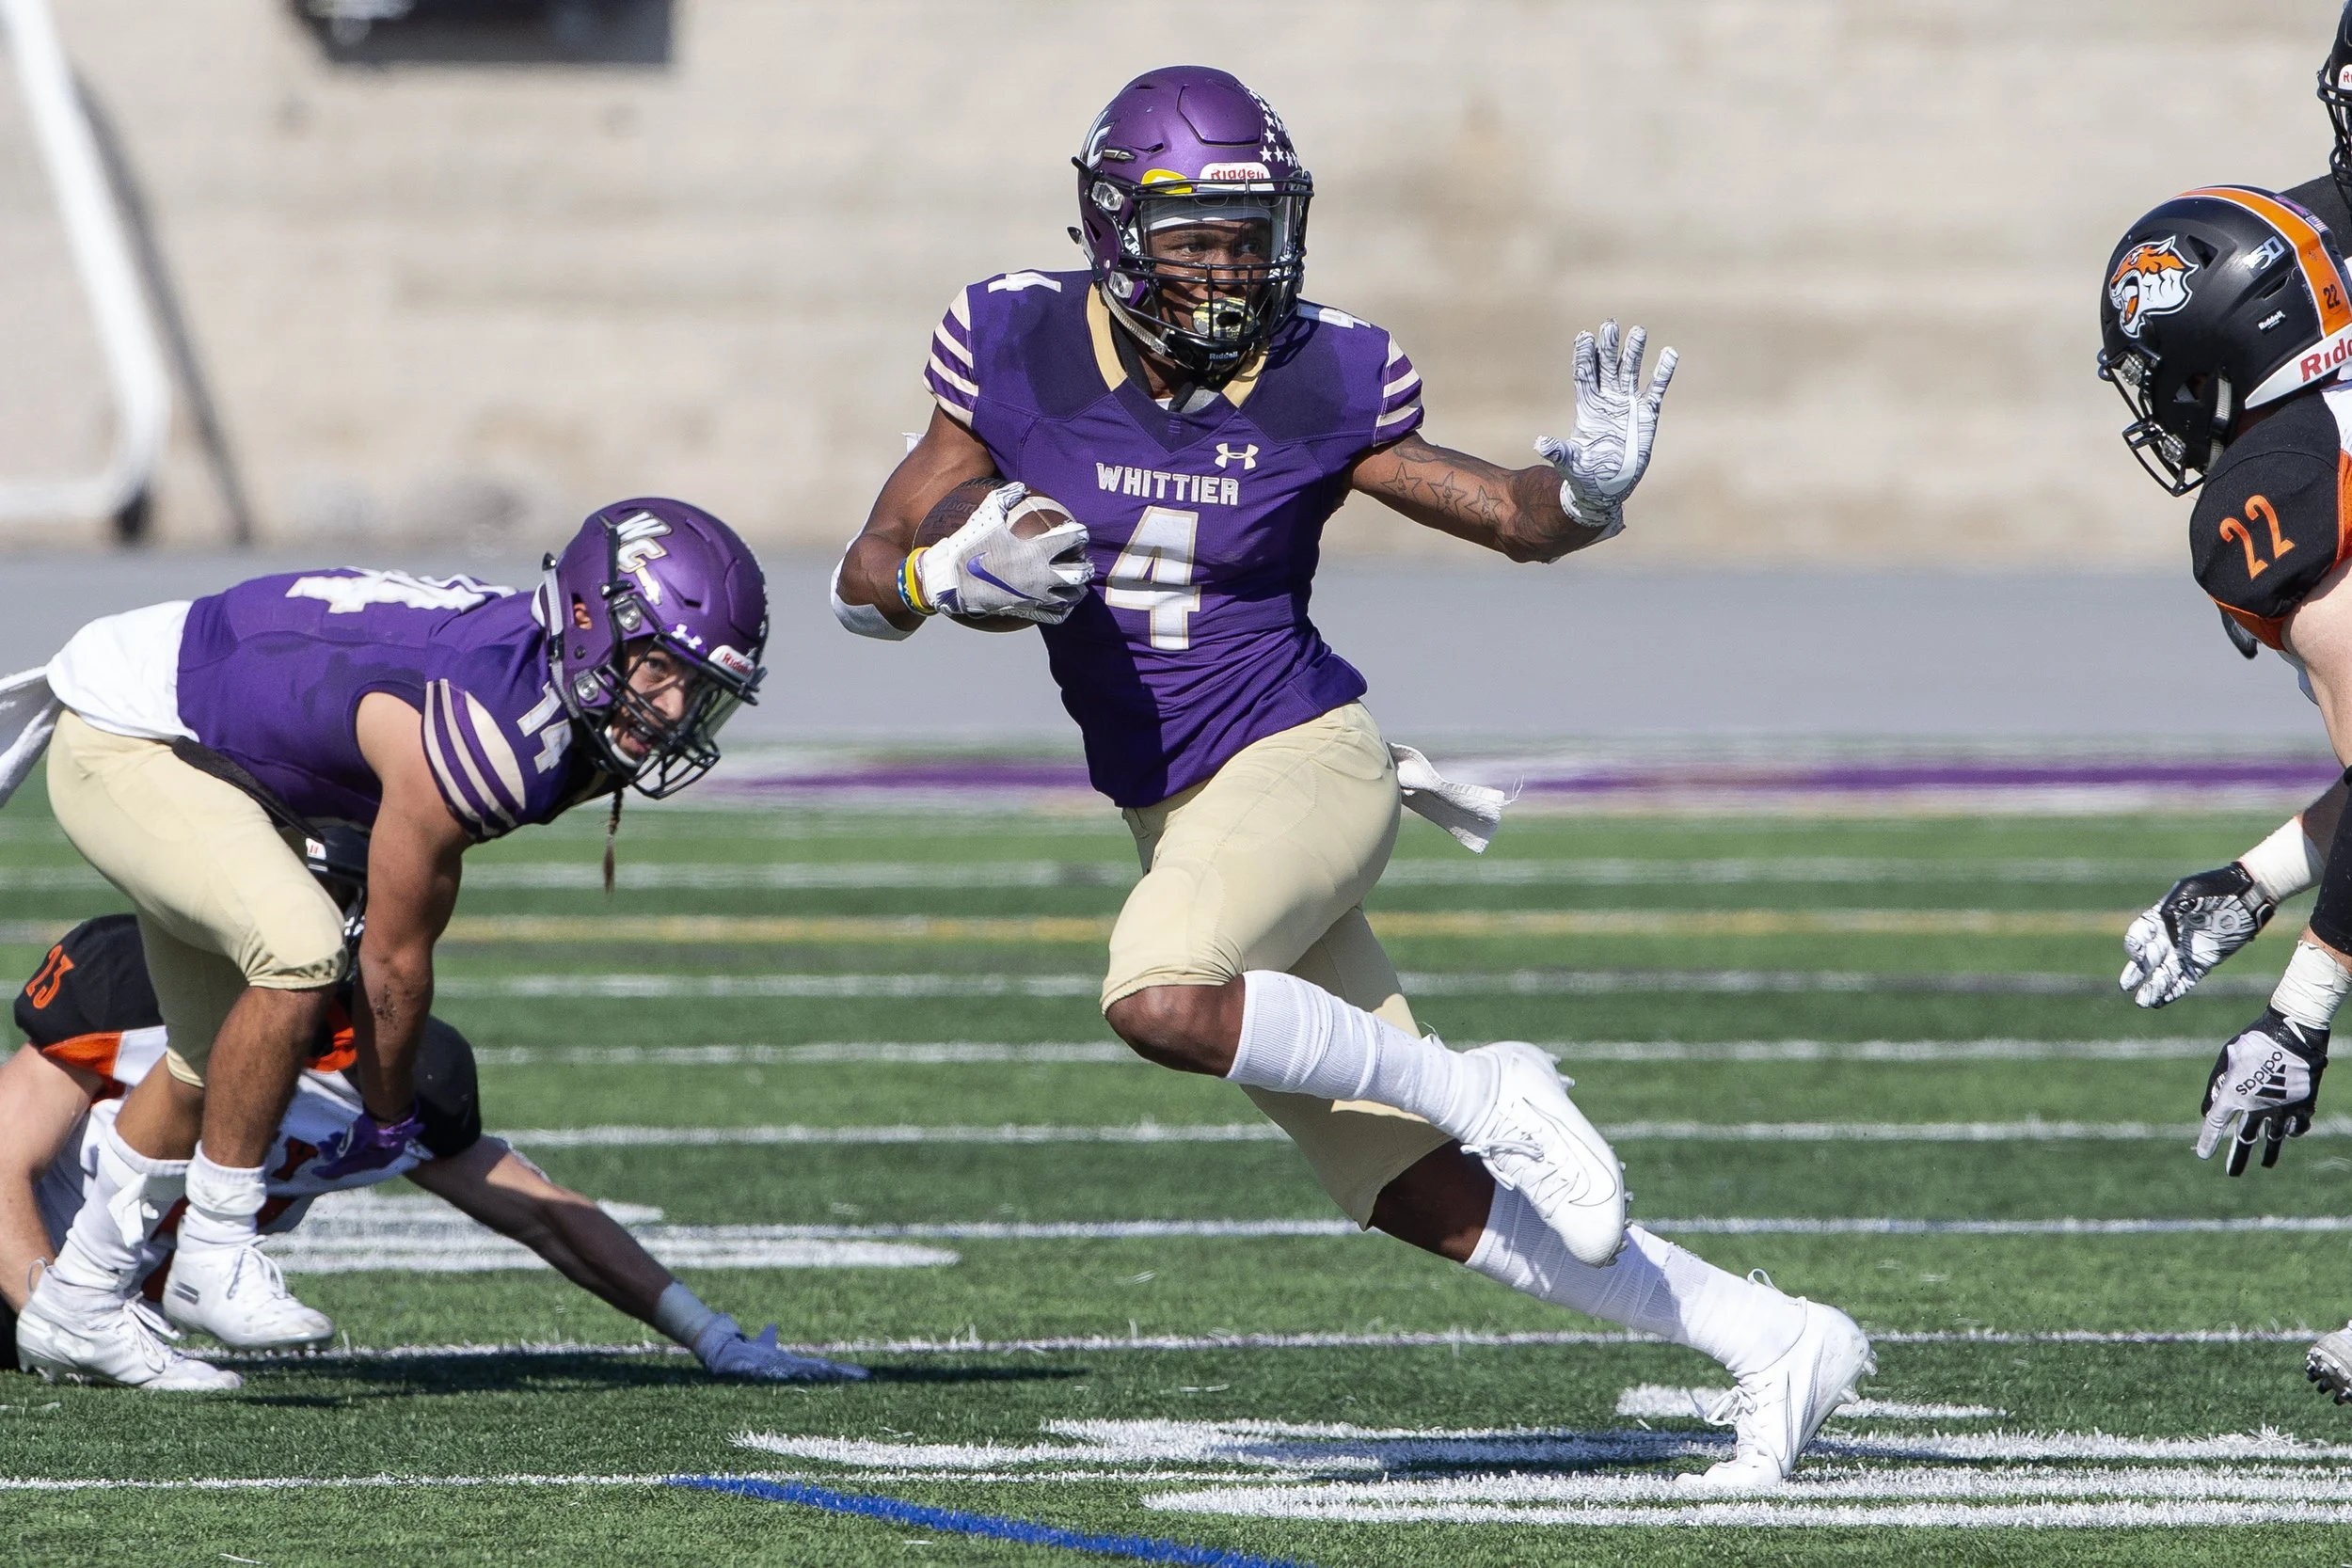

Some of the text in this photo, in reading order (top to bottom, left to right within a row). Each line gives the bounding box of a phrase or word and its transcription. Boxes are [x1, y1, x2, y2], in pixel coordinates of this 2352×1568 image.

[2323, 284, 2341, 309] 22
[1096, 462, 1239, 505] WHITTIER
[2219, 495, 2295, 579] 22
[1105, 505, 1201, 650] 4
